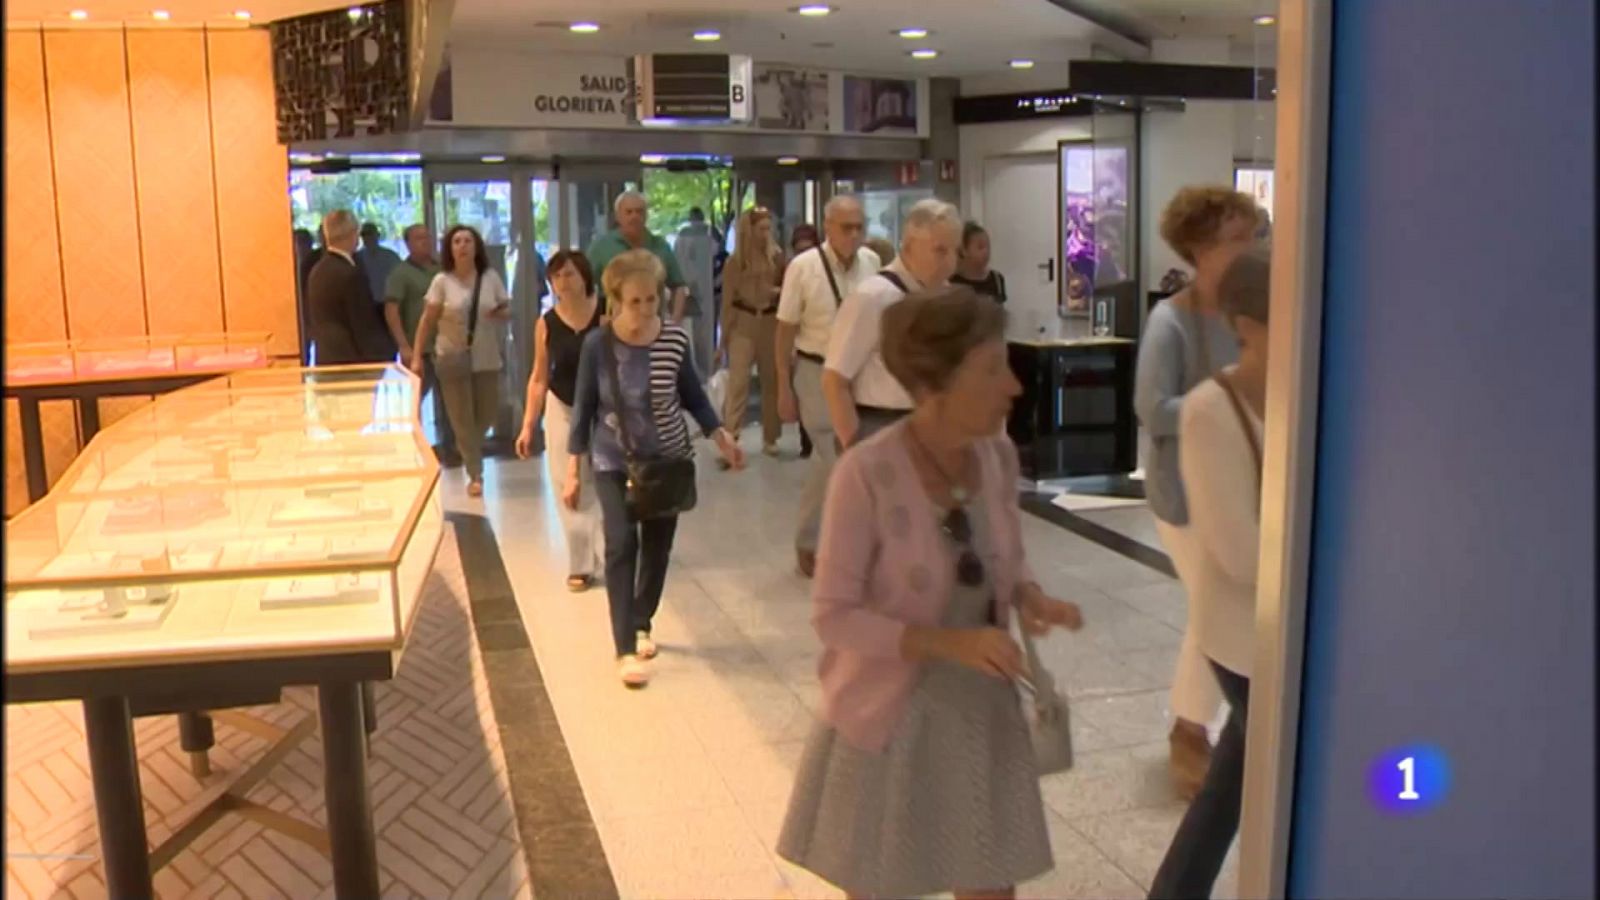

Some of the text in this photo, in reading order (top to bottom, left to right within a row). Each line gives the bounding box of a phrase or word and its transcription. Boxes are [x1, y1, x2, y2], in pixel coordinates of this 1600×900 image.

[580, 75, 626, 92] SALID
[732, 84, 744, 103] B
[534, 94, 615, 113] GLORIETA
